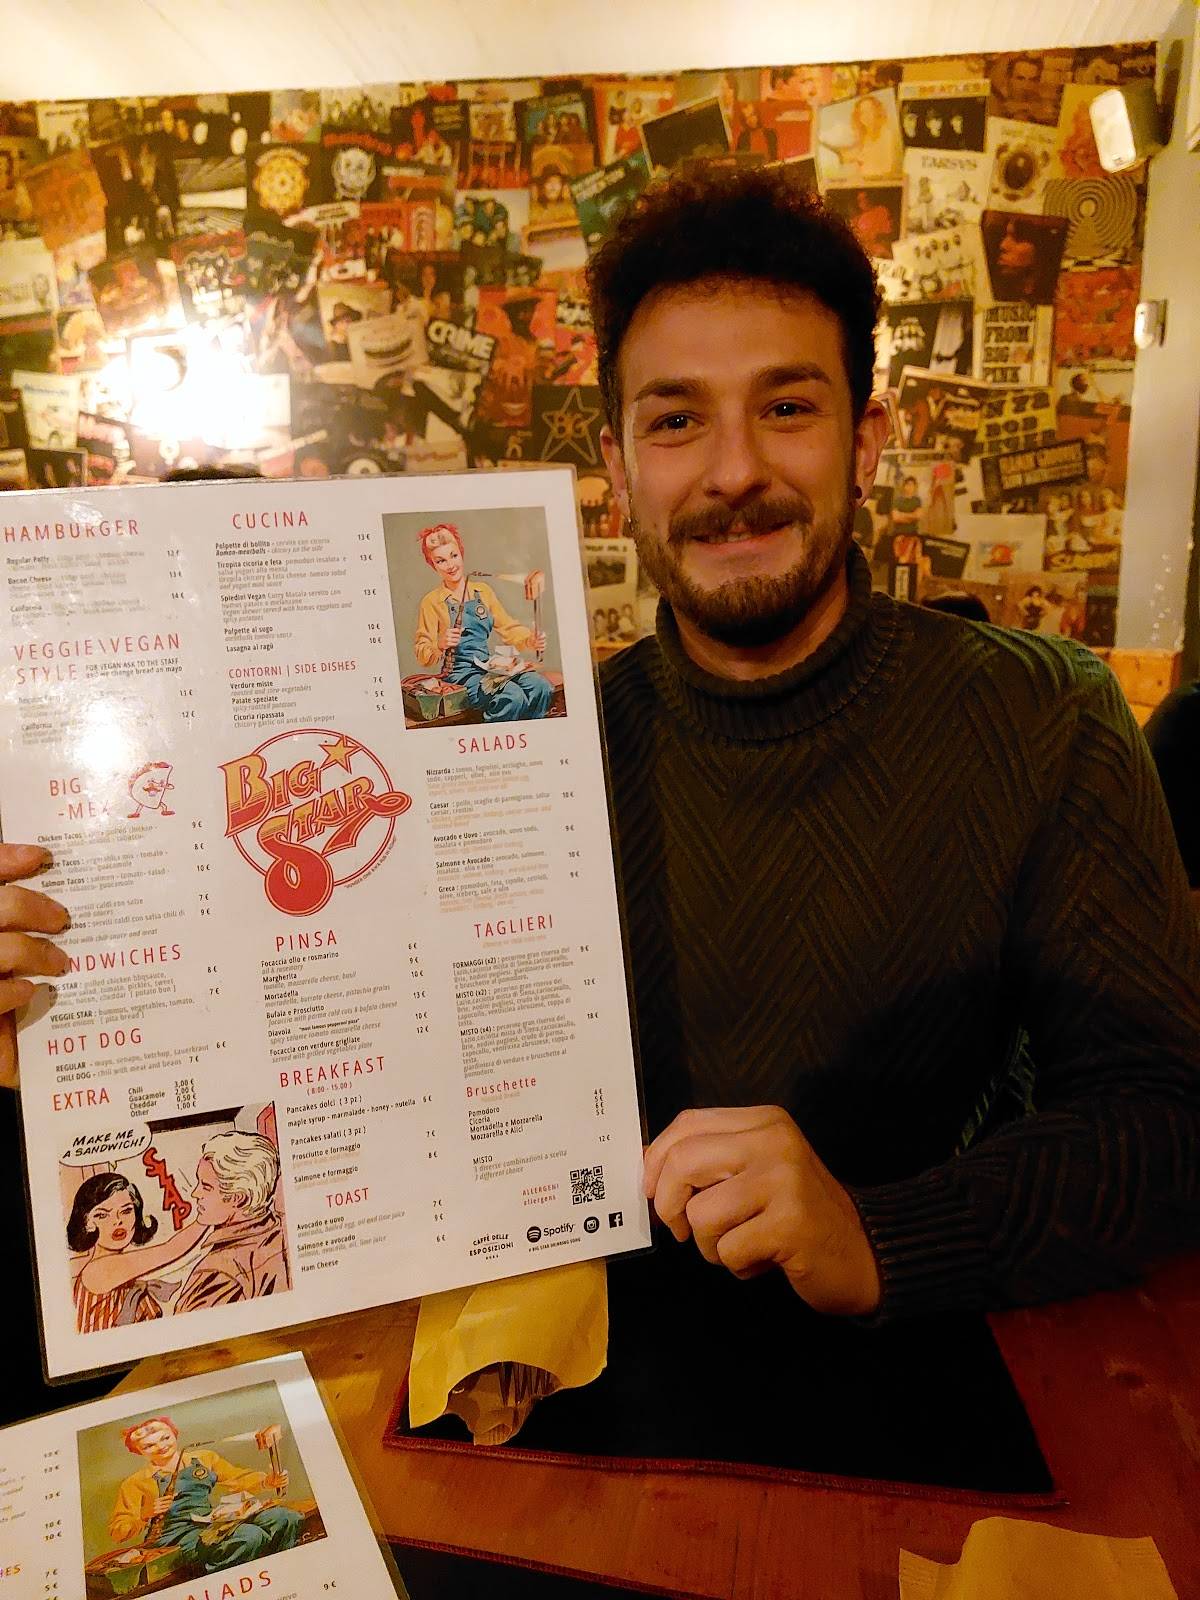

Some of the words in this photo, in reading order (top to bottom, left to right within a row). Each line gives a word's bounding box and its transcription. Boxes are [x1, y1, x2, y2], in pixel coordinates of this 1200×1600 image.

[232, 511, 308, 529] CUCINA
[4, 520, 139, 543] HAMBURGER
[216, 542, 240, 550] Polpette
[217, 560, 241, 568] Tiropita
[224, 627, 250, 636] Polpette
[259, 626, 273, 634] sugo
[101, 662, 121, 671] VEGAN
[124, 661, 135, 669] ASK
[137, 660, 145, 668] TO
[147, 659, 158, 667] THE
[160, 658, 179, 666] STAFF
[229, 666, 282, 678] CONTORNI
[295, 663, 317, 674] SIDE
[321, 661, 356, 671] DISHES
[17, 664, 77, 685] STYLE
[253, 696, 278, 704] speziate
[257, 712, 284, 720] ripassata
[459, 733, 527, 754] SALADS
[50, 778, 81, 796] BIG
[218, 753, 322, 837] BIG
[38, 834, 62, 843] Chicken
[434, 834, 457, 842] Avocado
[257, 777, 412, 917] STAR
[62, 859, 80, 867] Tacos
[436, 860, 460, 868] Salmone
[467, 856, 490, 864] Avocado
[42, 880, 64, 888] Salmon
[67, 878, 85, 886] Tacos
[474, 914, 553, 938] TAGLIERI
[276, 930, 337, 952] PINSA
[69, 945, 181, 973] NDWICHES
[261, 959, 287, 967] Focaccia
[308, 952, 339, 961] rosmarino
[453, 959, 483, 969] FORMAGGI
[484, 957, 496, 966] (x2)
[263, 973, 297, 983] Margherita
[62, 982, 78, 991] STAR
[265, 991, 298, 1000] Mortadella
[455, 991, 473, 999] MISTO
[475, 989, 486, 997] (x2)
[294, 1005, 324, 1014] Prosciutto
[51, 1012, 74, 1023] VEGGIE
[77, 1011, 92, 1019] STAR
[268, 1029, 291, 1037] Diavola
[460, 1028, 478, 1036] MISTO
[480, 1026, 491, 1034] (x4)
[48, 1036, 86, 1056] HOT
[100, 1028, 142, 1048] DOG
[270, 1046, 295, 1056] Focaccia
[310, 1041, 334, 1049] verdure
[336, 1036, 360, 1046] grigliate
[56, 1062, 86, 1072] REGULAR
[280, 1056, 384, 1087] BREAKFAST
[57, 1074, 74, 1083] CHILI
[76, 1072, 91, 1080] DOG
[129, 1087, 143, 1095] Chili
[175, 1080, 188, 1088] 3,00
[467, 1077, 537, 1097] Bruschette
[53, 1088, 110, 1112] EXTRA
[129, 1091, 166, 1102] Guacamole
[130, 1100, 157, 1109] Cheddar
[177, 1094, 190, 1102] 0,50
[131, 1109, 149, 1117] Other
[177, 1102, 190, 1111] 1,00
[287, 1103, 318, 1114] Pancakes
[320, 1099, 336, 1108] dolci
[288, 1119, 307, 1127] maple
[309, 1115, 325, 1126] syrup
[332, 1108, 365, 1120] marmalade
[372, 1105, 389, 1113] honey
[395, 1099, 416, 1108] nutella
[469, 1106, 500, 1117] Pomodoro
[469, 1116, 490, 1125] Cicoria
[470, 1119, 503, 1132] Mortadella
[511, 1114, 543, 1126] Mozzarella
[73, 1132, 111, 1147] MAKE
[116, 1129, 134, 1139] ME
[291, 1135, 321, 1146] Pancakes
[324, 1131, 341, 1141] salati
[471, 1130, 503, 1141] Mozzarella
[511, 1126, 523, 1134] Alici
[63, 1150, 71, 1158] A
[75, 1136, 145, 1157] SANDWICH!
[292, 1151, 323, 1161] Prosciutto
[330, 1143, 360, 1154] formaggio
[473, 1156, 492, 1165] MISTO
[294, 1174, 320, 1183] Salmone
[328, 1165, 358, 1177] formaggio
[523, 1184, 559, 1196] ALLERGENI
[326, 1188, 369, 1208] TOAST
[524, 1195, 556, 1206] allergens
[297, 1220, 322, 1230] Avocado
[330, 1216, 344, 1224] uovo
[543, 1223, 574, 1237] Spotify
[297, 1241, 323, 1252] Salmone
[331, 1234, 355, 1245] avocado
[470, 1242, 514, 1256] ESPOSIZIONI
[302, 1264, 315, 1272] Ham
[317, 1259, 338, 1269] Cheese
